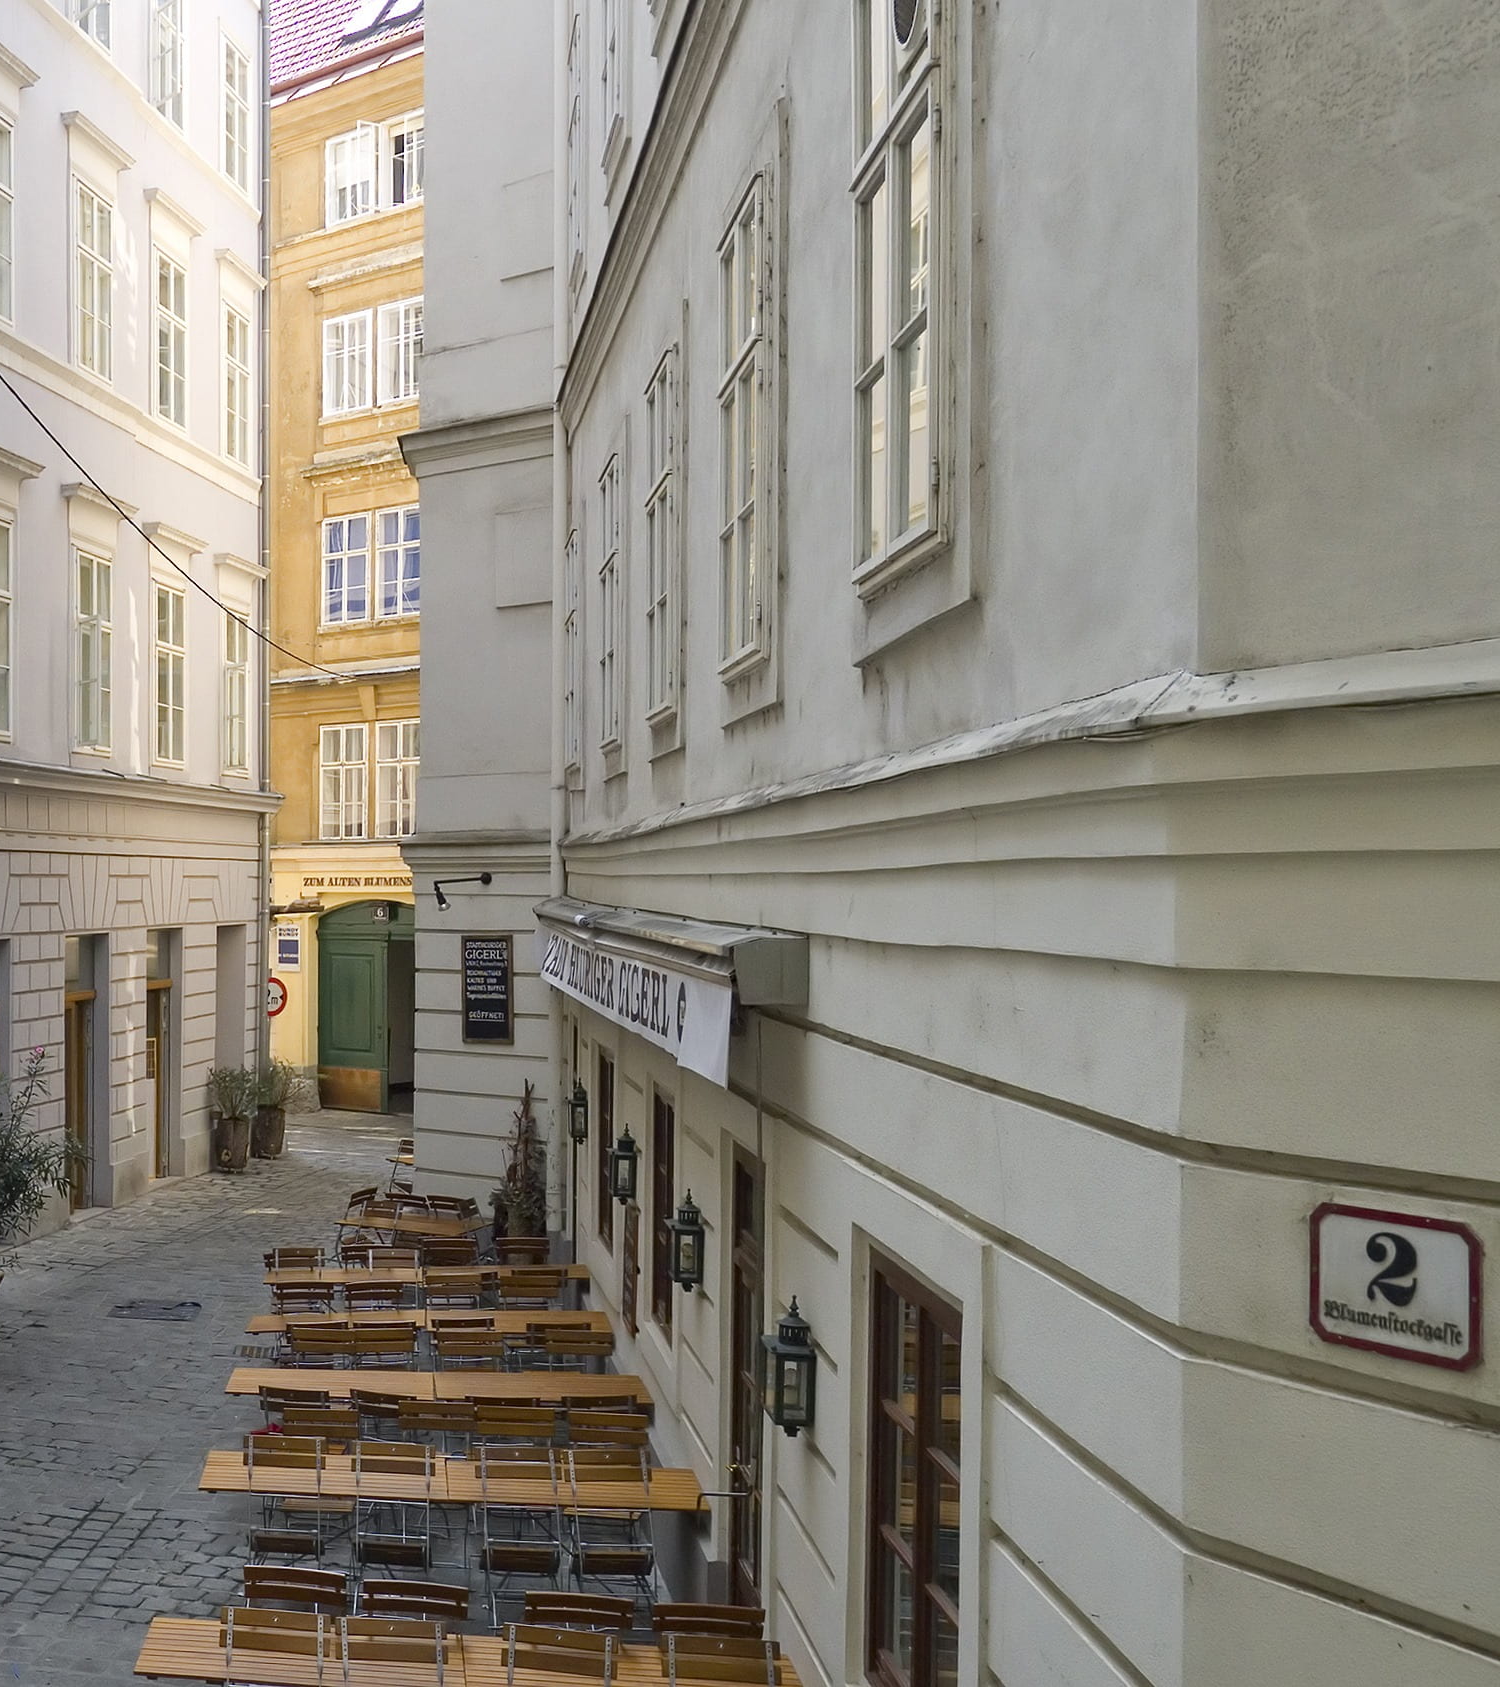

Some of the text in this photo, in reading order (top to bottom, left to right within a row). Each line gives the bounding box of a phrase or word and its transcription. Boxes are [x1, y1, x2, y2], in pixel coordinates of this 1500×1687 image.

[303, 877, 324, 887] ZUM
[327, 877, 362, 887] ALTEN
[377, 907, 384, 917] 6
[465, 949, 503, 960] GIGERL
[618, 961, 669, 1038] GIGERL
[1366, 1231, 1418, 1307] 2
